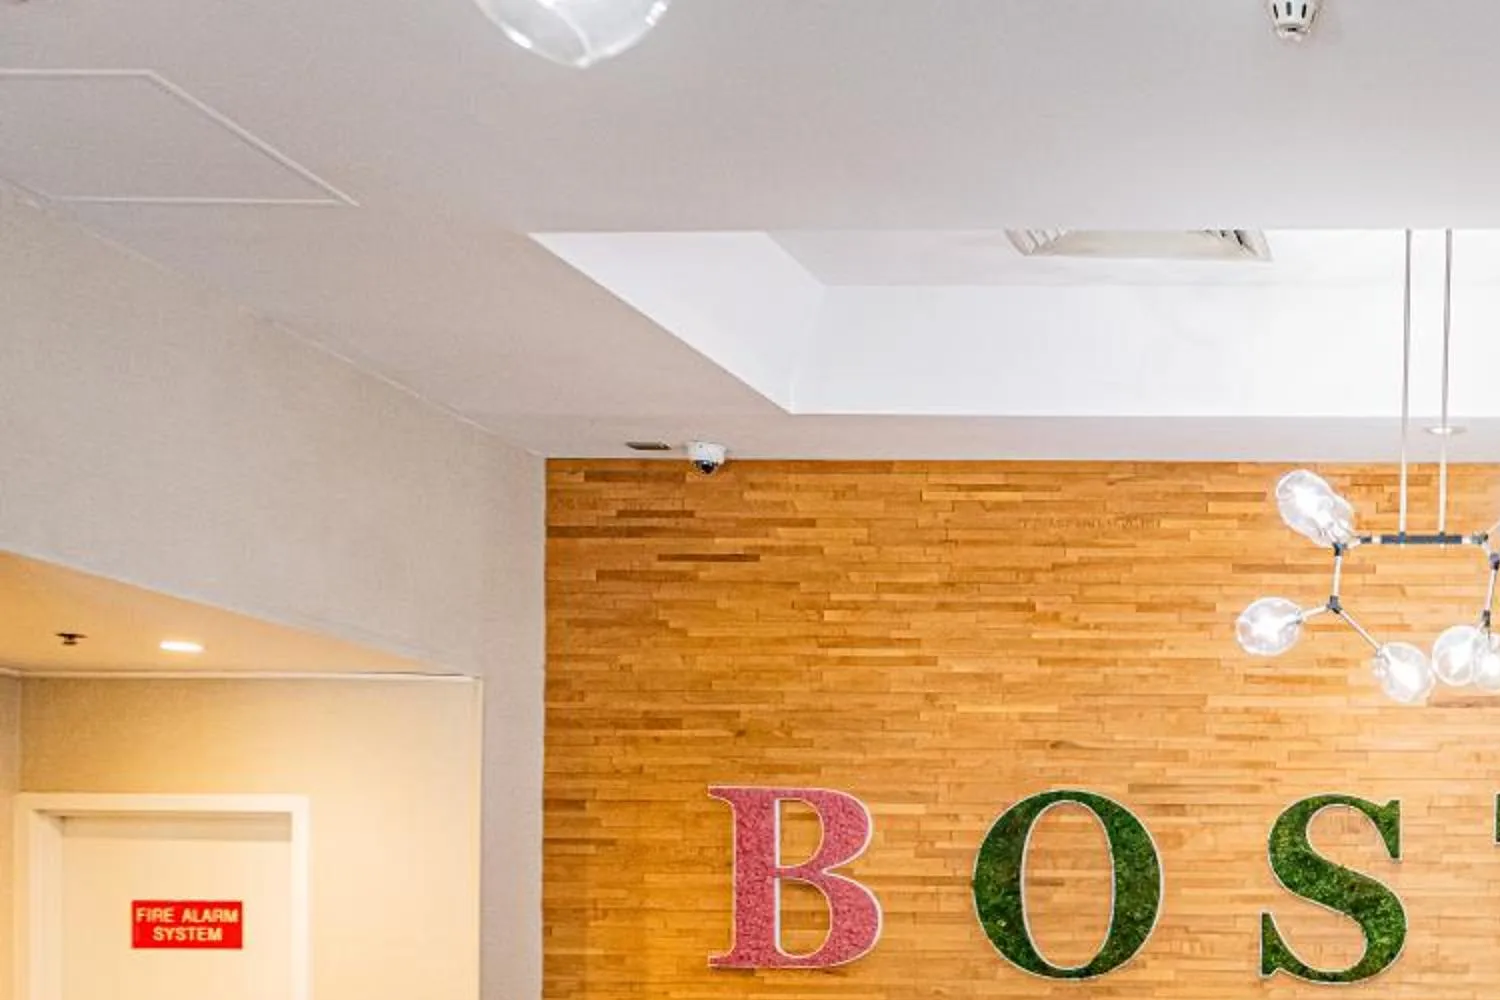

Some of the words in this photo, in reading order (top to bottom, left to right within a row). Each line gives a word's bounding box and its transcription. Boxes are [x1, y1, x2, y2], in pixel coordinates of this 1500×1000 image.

[135, 907, 175, 923] FIRE
[181, 907, 239, 923] ALARM
[152, 925, 223, 942] SYSTEM
